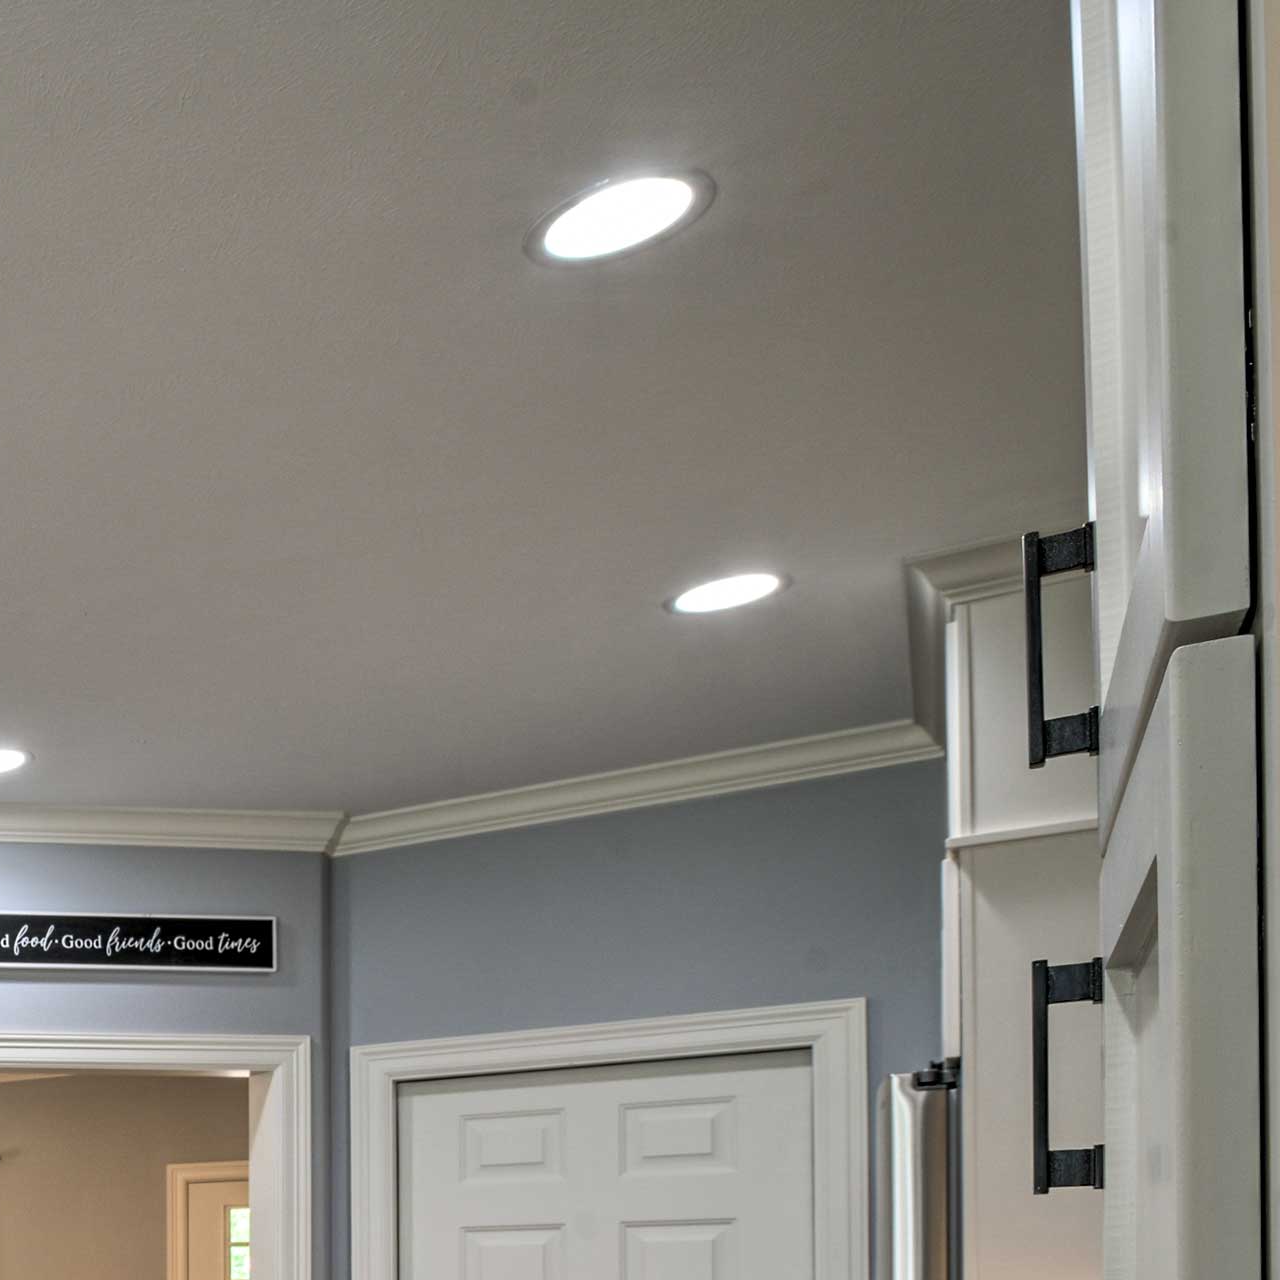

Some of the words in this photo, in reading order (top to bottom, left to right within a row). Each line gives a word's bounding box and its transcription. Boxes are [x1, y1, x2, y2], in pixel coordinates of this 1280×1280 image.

[13, 924, 54, 956] food
[61, 934, 102, 949] Good
[106, 926, 165, 957] friends
[173, 935, 214, 950] Good
[217, 931, 261, 954] times
